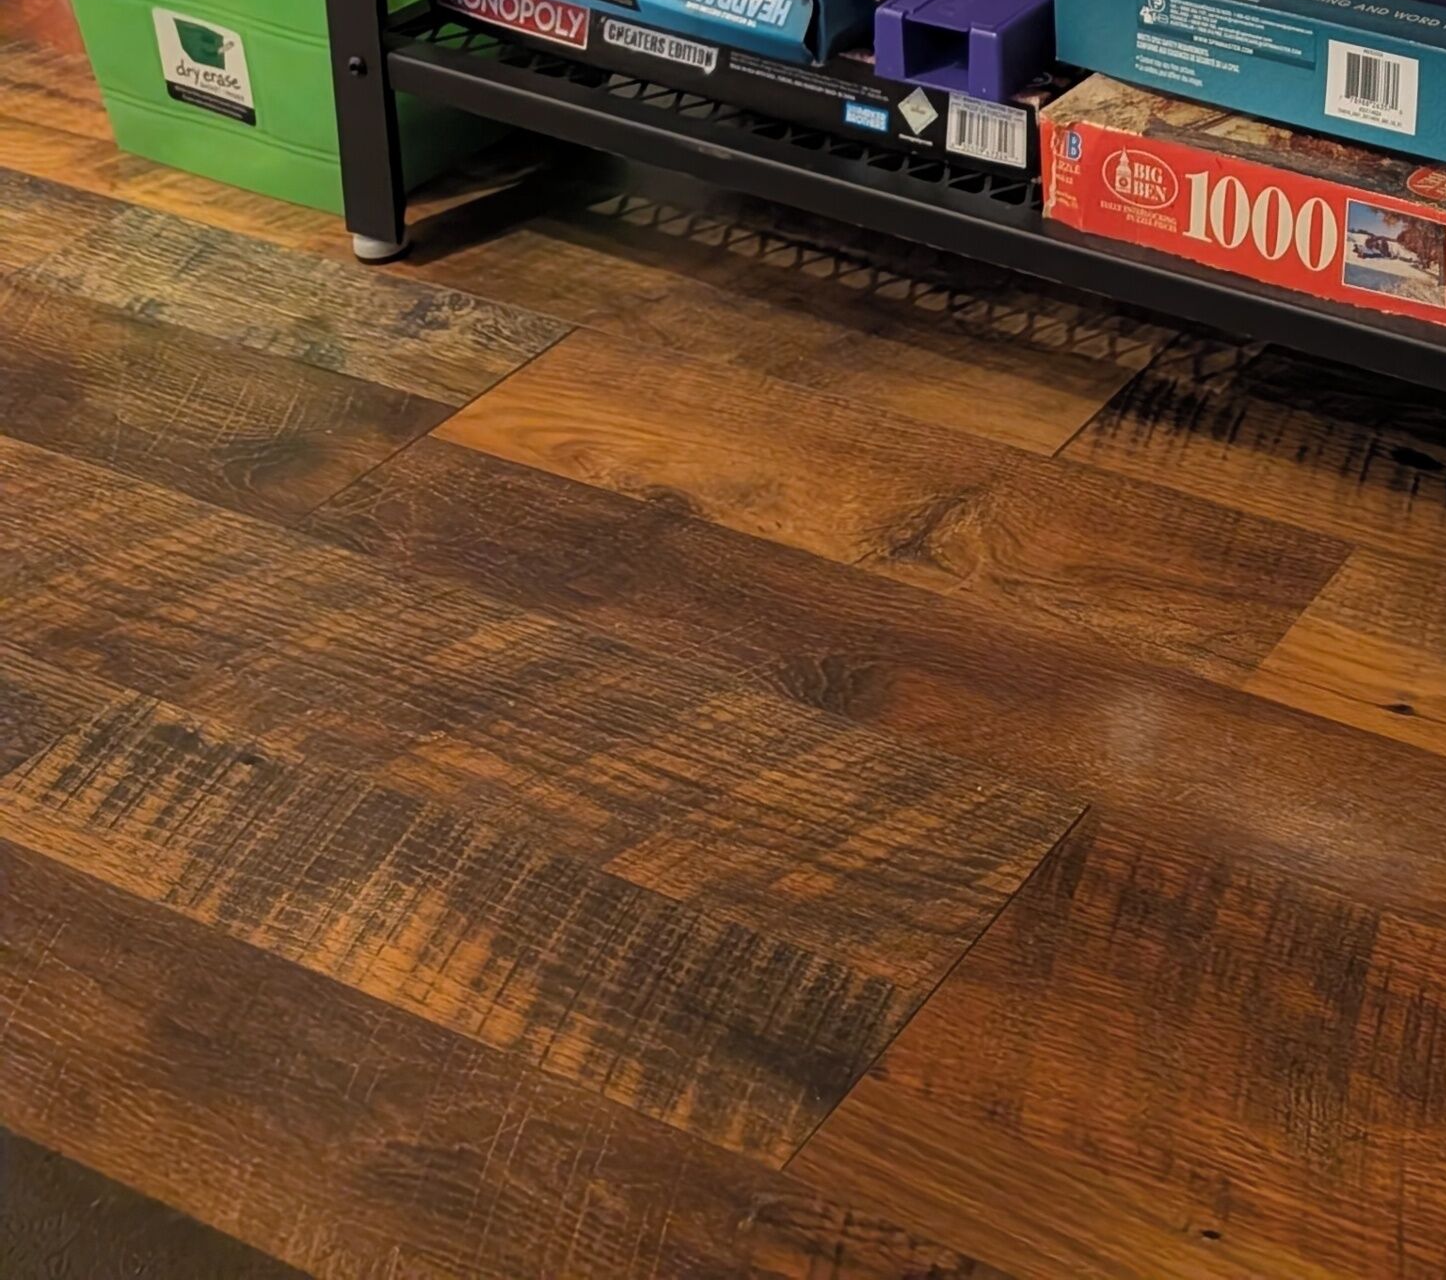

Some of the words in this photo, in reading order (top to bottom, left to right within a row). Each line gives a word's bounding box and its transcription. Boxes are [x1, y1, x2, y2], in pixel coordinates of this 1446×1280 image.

[1355, 1, 1391, 18] AND
[1393, 8, 1441, 28] WORD
[607, 23, 666, 53] CHEATERS
[668, 36, 714, 68] EDITION
[175, 59, 201, 89] dry
[202, 67, 242, 92] erase
[1133, 162, 1163, 185] BIG
[1132, 180, 1167, 203] BEN
[1100, 200, 1121, 212] FULLY
[1181, 169, 1338, 273] 1000
